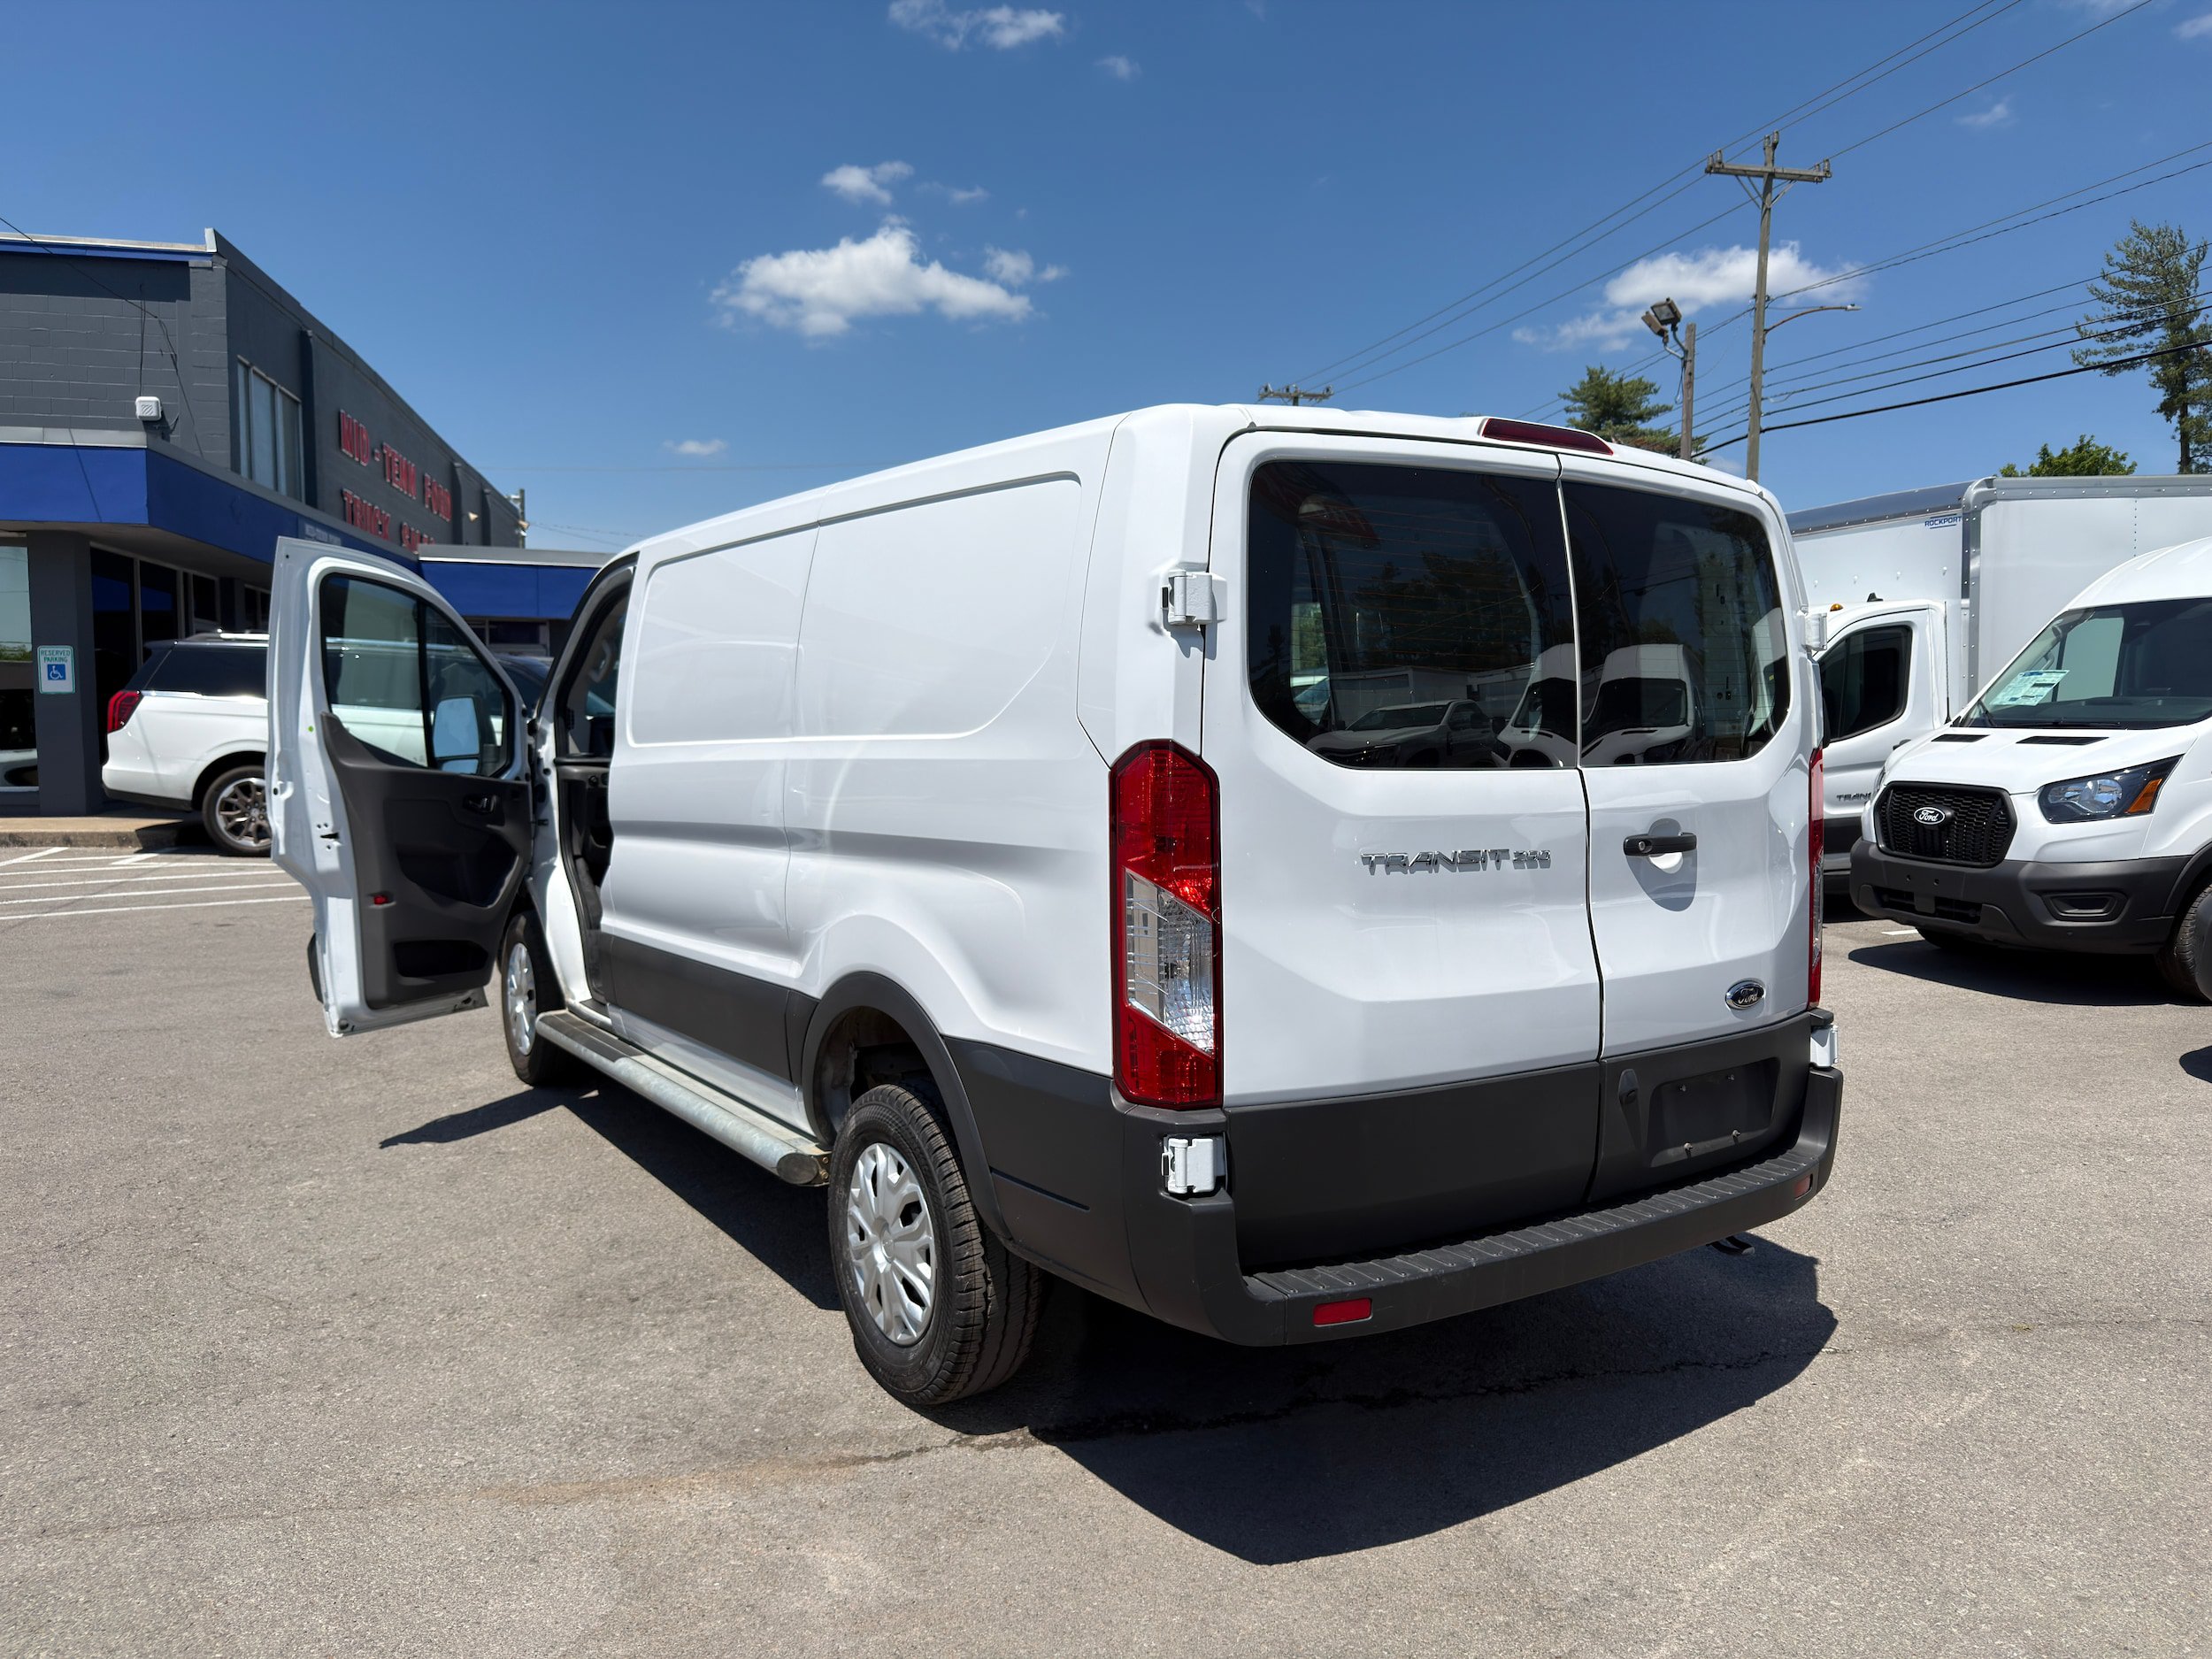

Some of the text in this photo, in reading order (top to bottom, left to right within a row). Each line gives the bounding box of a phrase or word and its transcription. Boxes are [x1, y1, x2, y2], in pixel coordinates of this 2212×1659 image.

[424, 472, 452, 522] FORD
[342, 488, 391, 541] TRUCK
[1924, 516, 1962, 526] ROCKPORT
[1918, 809, 1939, 822] Ford
[1361, 849, 1510, 872] TRANSIT
